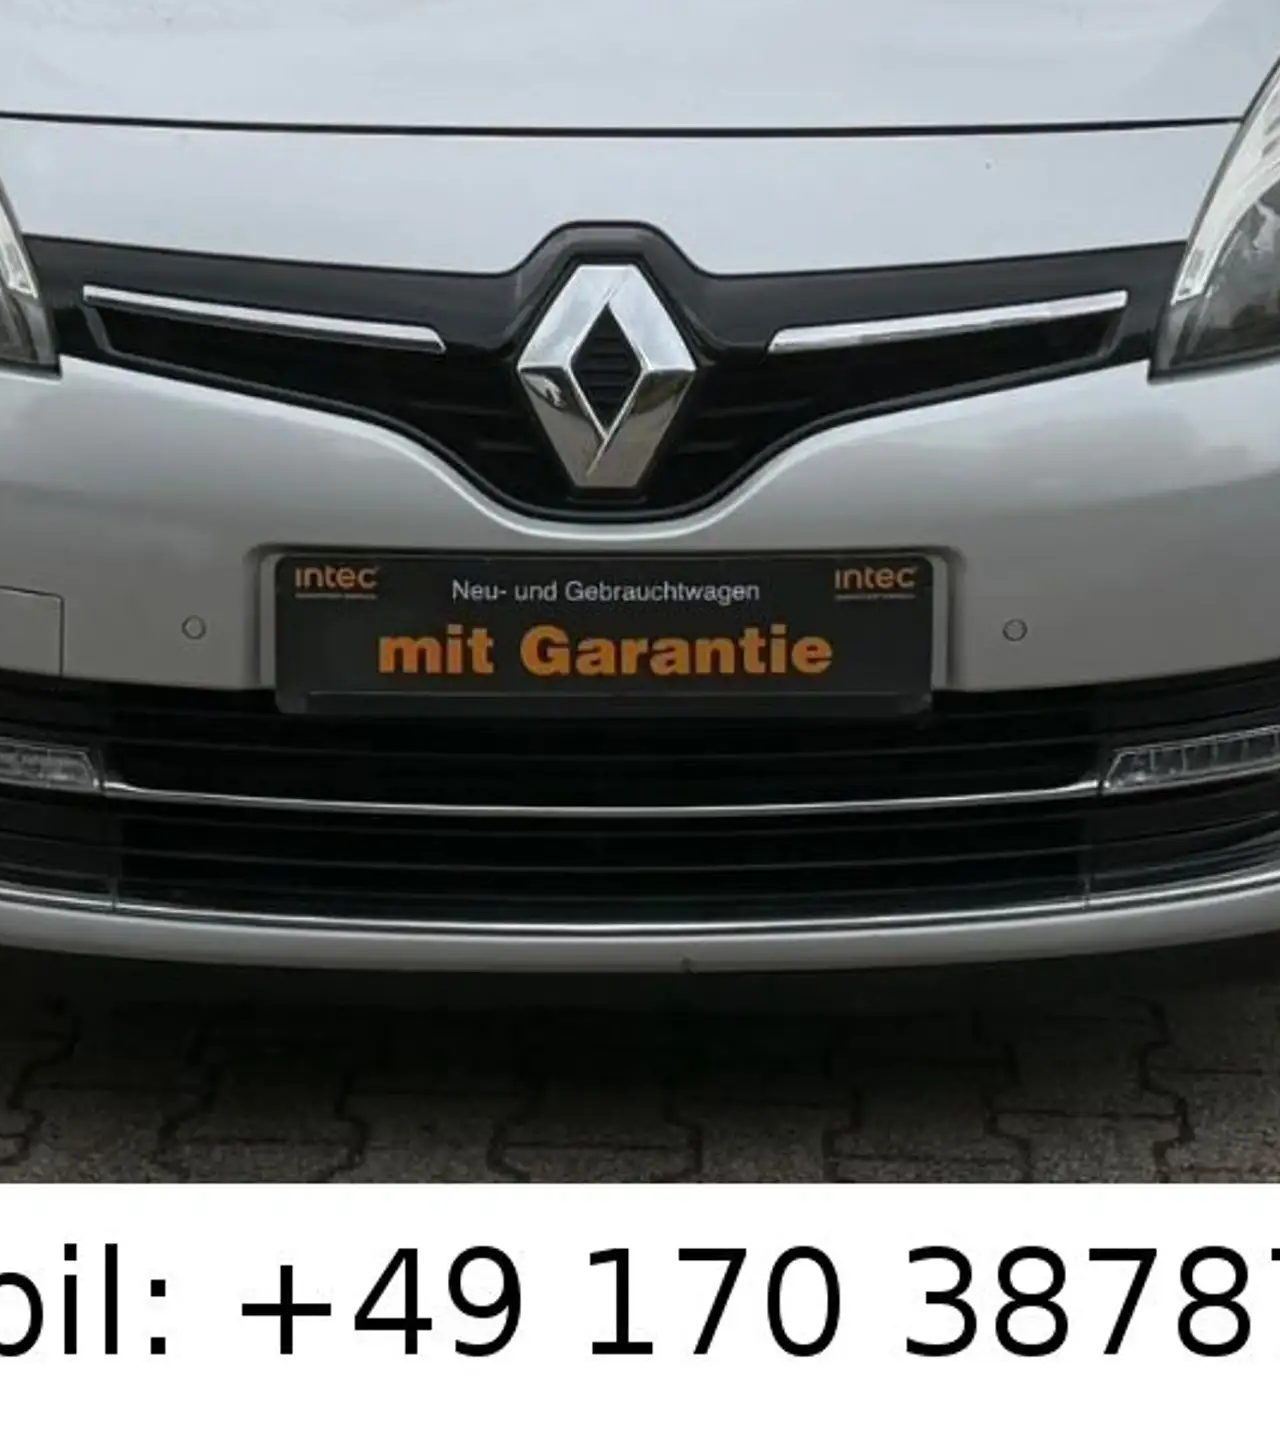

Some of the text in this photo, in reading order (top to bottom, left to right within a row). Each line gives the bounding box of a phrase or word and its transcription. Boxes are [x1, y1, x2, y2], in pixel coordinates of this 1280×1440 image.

[294, 565, 380, 589] intec
[834, 566, 917, 589] intec
[451, 579, 760, 606] Neu- und Gebrauchtwagen
[378, 623, 834, 677] mit Garantie
